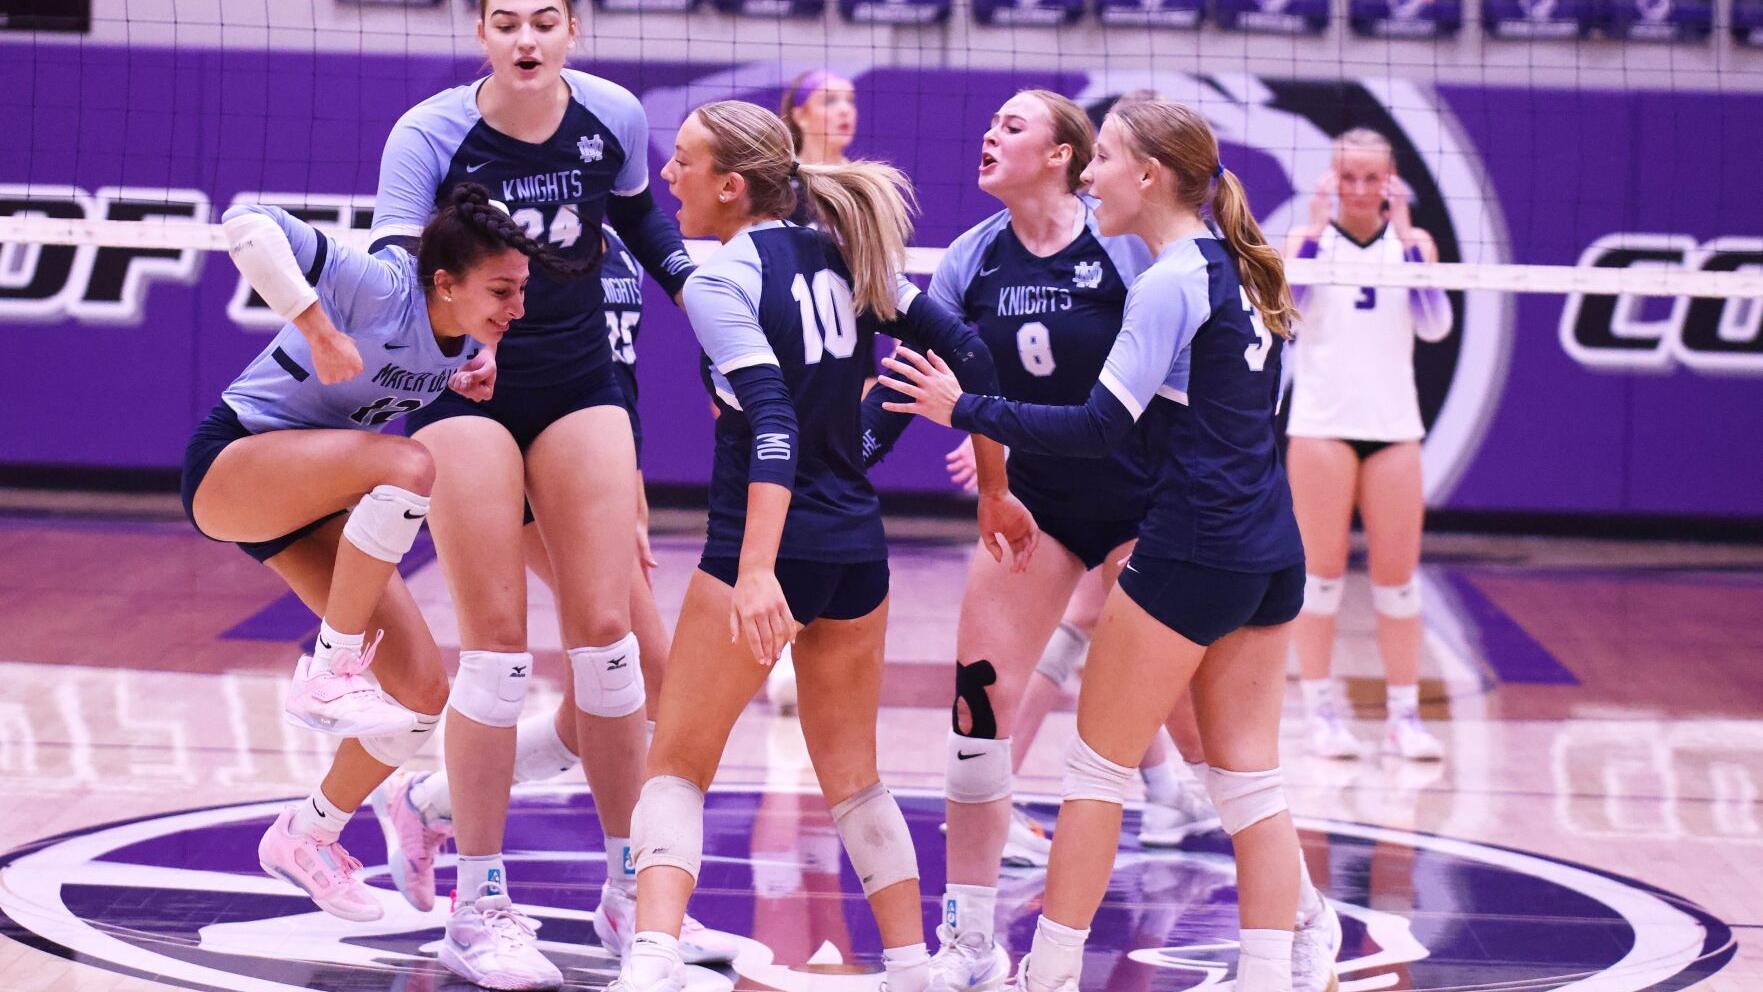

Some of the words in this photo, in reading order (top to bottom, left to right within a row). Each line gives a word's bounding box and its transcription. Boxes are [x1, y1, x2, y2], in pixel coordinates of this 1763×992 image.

[502, 169, 583, 203] KNIGHTS
[600, 277, 643, 305] NIGHTS
[997, 285, 1073, 317] KNIGHTS
[790, 268, 858, 365] 10
[604, 310, 641, 365] 25
[1016, 321, 1057, 377] 8
[371, 362, 432, 393] MATER
[349, 395, 424, 426] 12
